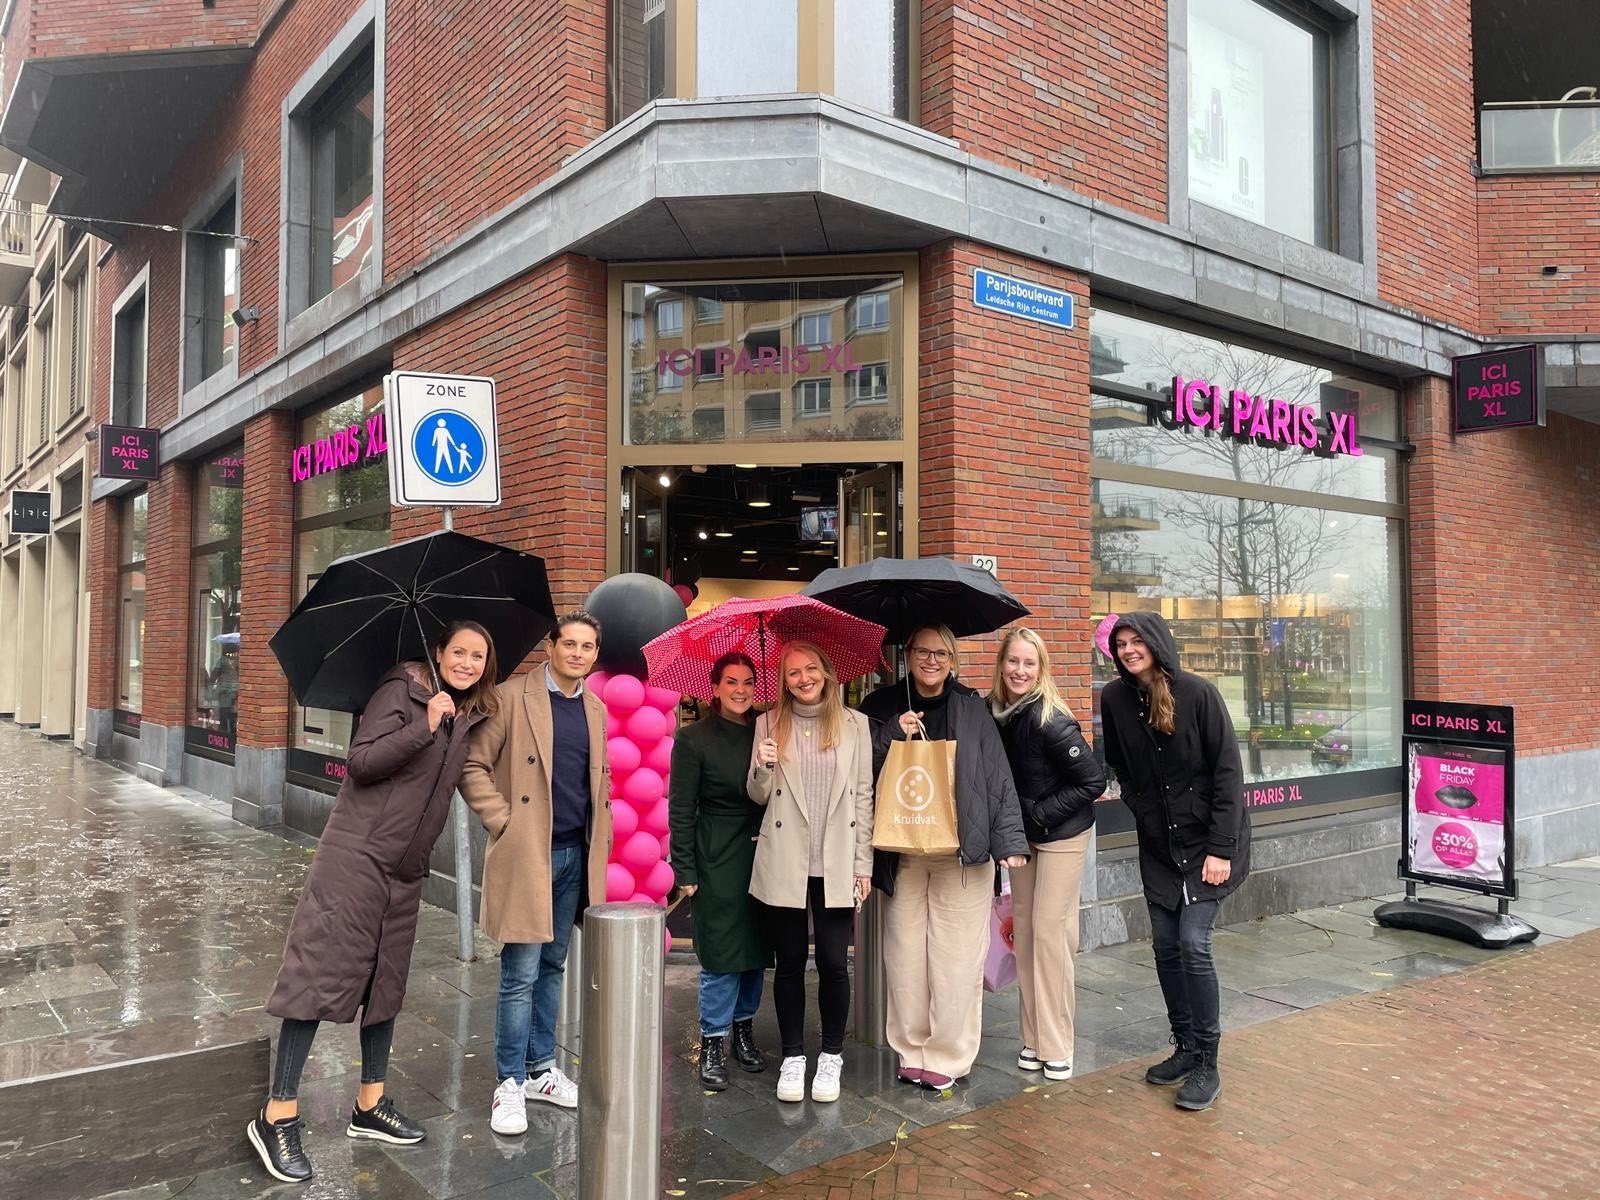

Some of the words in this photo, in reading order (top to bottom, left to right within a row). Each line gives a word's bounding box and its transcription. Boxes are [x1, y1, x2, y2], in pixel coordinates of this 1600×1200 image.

[986, 275, 1064, 308] Parijsboulevard
[985, 293, 1015, 308] Leidsche
[1016, 301, 1031, 313] Rijn
[1031, 305, 1059, 319] Centrum
[659, 350, 704, 377] ICI
[715, 346, 810, 375] PARIS
[821, 344, 862, 373] XL
[1482, 364, 1507, 380] ICI
[426, 384, 467, 397] ZONE
[1468, 381, 1521, 401] PARIS
[1173, 374, 1222, 430] ICI
[1230, 388, 1318, 449] PARIS
[1326, 411, 1363, 456] XL
[1483, 401, 1506, 417] XL
[122, 435, 140, 446] ICI
[292, 443, 311, 482] ICI
[315, 424, 359, 475] PARIS
[366, 413, 388, 457] XL
[111, 446, 149, 459] PARIS
[122, 459, 139, 470] XL
[1411, 713, 1431, 727] ICI
[1436, 715, 1479, 731] PARIS
[1486, 719, 1506, 734] XL
[325, 761, 333, 775] ICI
[1439, 763, 1475, 776] BLACK
[1439, 773, 1475, 786] FRIDAY
[1253, 786, 1285, 806] PARIS
[1289, 785, 1303, 801] XL
[894, 813, 936, 825] Kruidvat
[1435, 832, 1474, 850] -30%
[1435, 845, 1448, 853] OP
